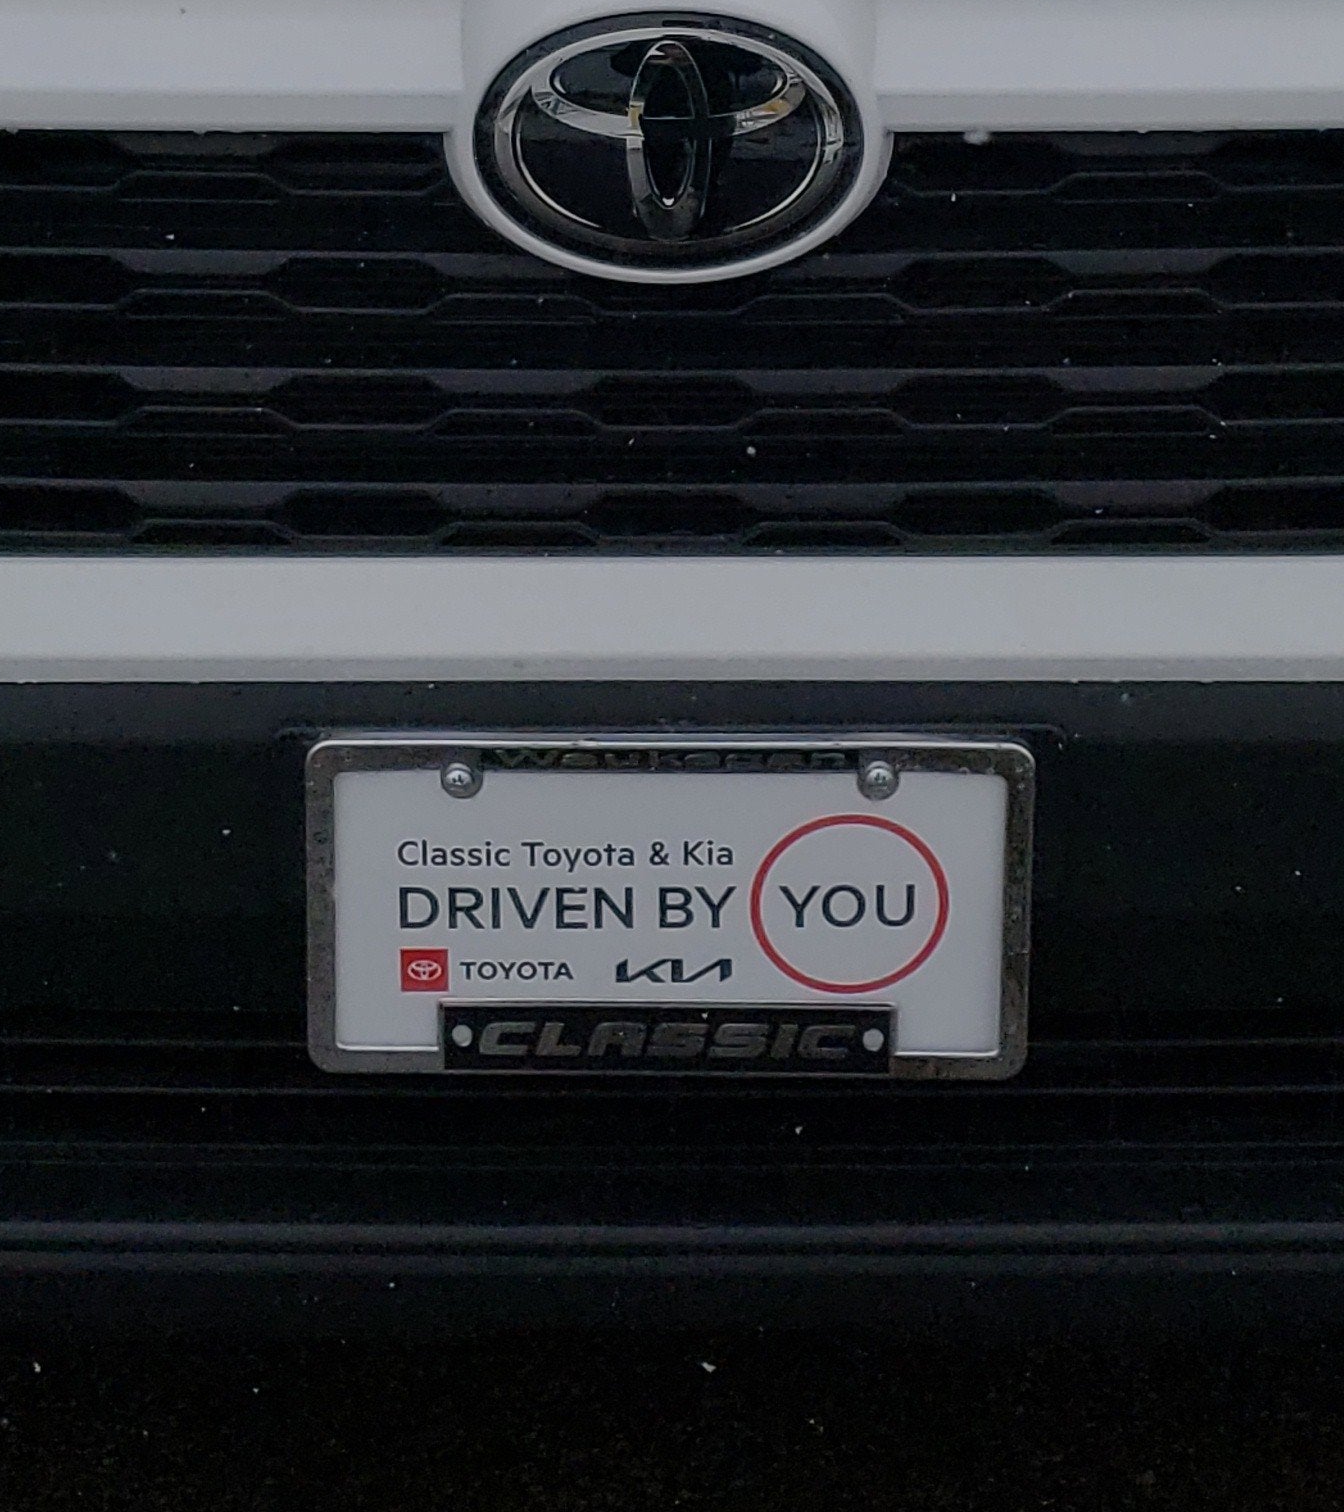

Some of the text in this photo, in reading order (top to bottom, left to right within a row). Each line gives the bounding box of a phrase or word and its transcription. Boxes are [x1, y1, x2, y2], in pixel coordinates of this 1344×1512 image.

[397, 839, 734, 873] Classic Toyota & Kia
[399, 884, 917, 929] DRIVEN BY YOU
[460, 961, 574, 980] TOYOTA
[478, 1021, 856, 1059] CLASSIC
